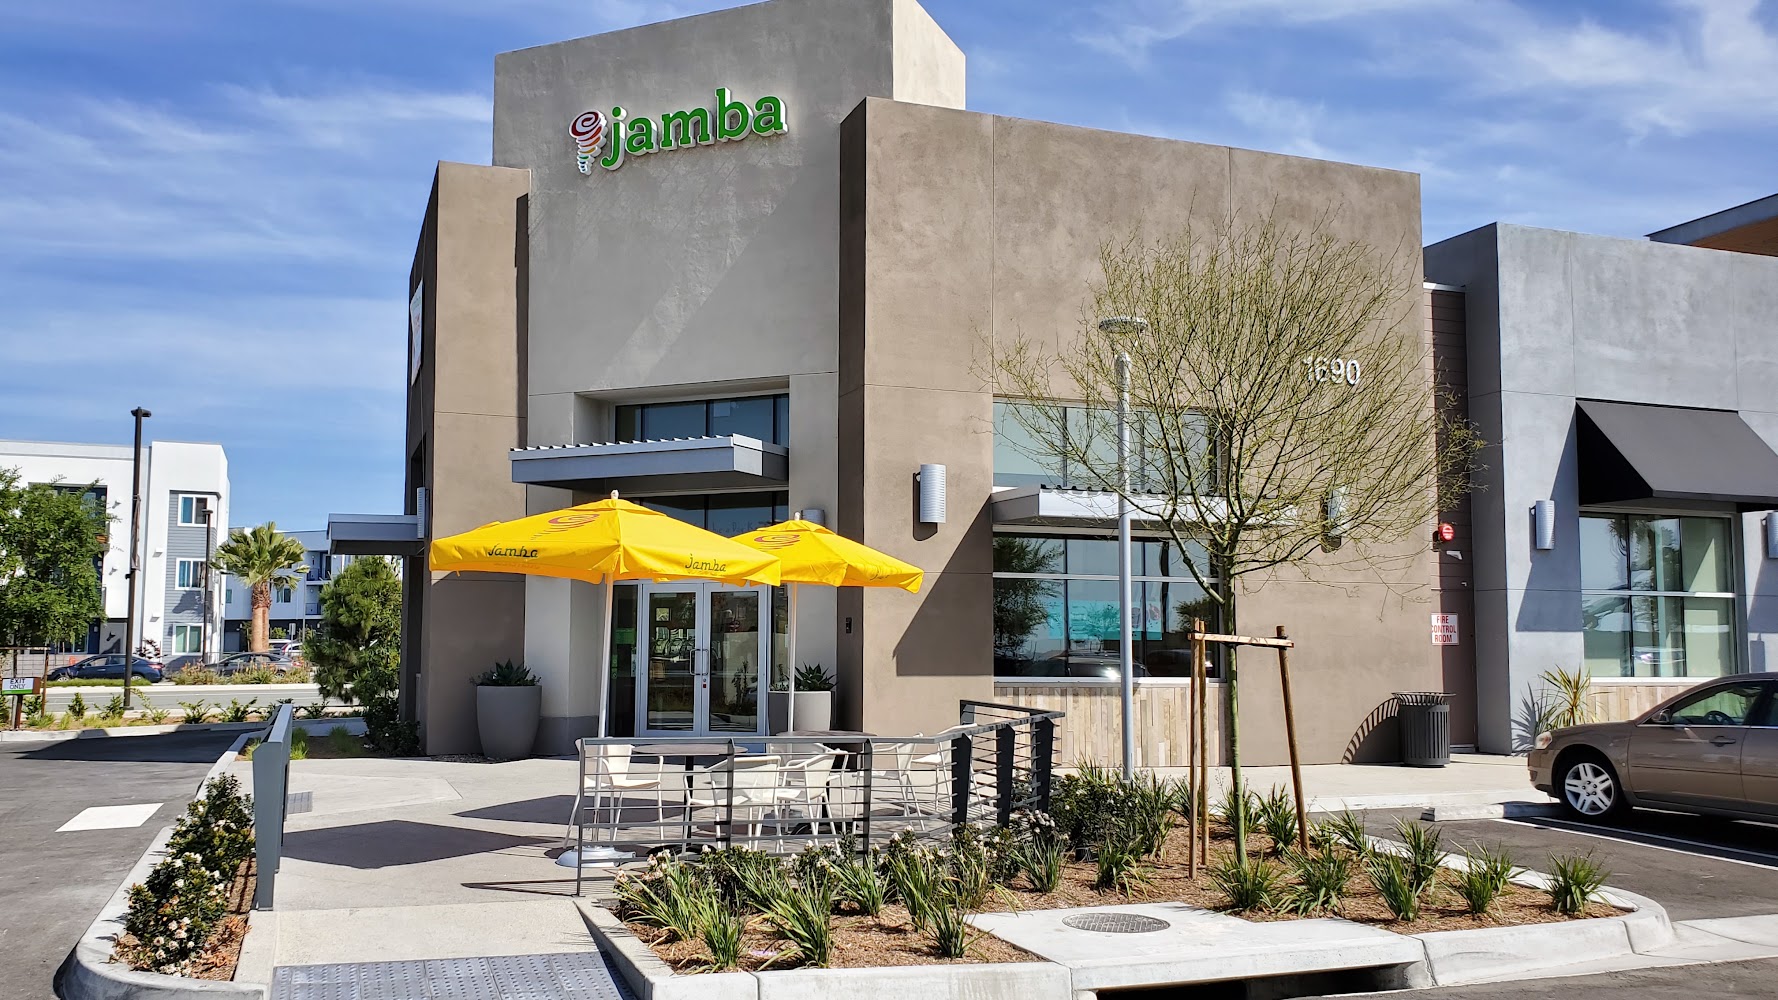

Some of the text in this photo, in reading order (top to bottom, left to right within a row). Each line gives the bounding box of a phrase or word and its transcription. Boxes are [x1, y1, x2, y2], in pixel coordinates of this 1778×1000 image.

[600, 87, 787, 170] jamba
[1302, 356, 1361, 385] 1690
[1437, 615, 1449, 624] FIRE
[1435, 634, 1452, 642] ROOM
